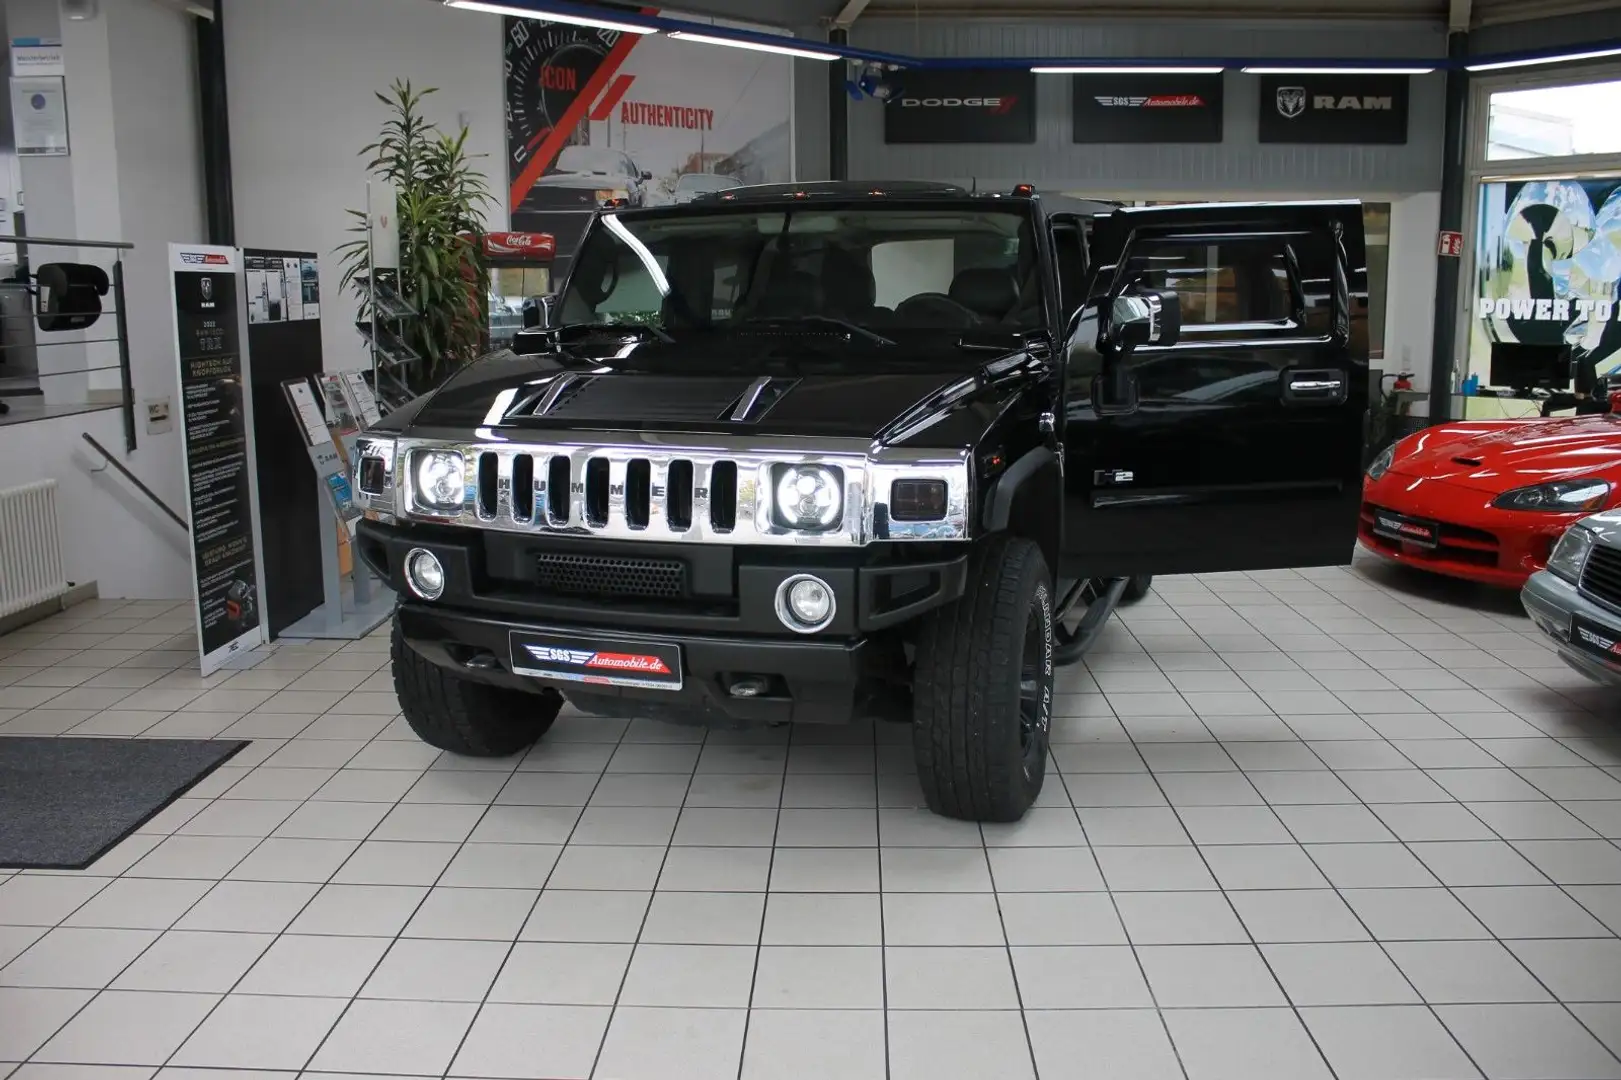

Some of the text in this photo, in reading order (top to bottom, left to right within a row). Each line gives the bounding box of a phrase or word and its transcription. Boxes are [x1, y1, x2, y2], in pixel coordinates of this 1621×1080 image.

[540, 65, 576, 91] ICON
[901, 98, 1001, 107] DODGE
[1113, 96, 1198, 106] SGS Automobile.de
[1313, 96, 1392, 110] RAM
[621, 101, 714, 131] AUTHENTICITY
[1480, 298, 1569, 321] POWER
[1575, 300, 1612, 322] TO
[498, 478, 709, 499] HUMMER
[549, 649, 663, 671] SGS Automobile.de
